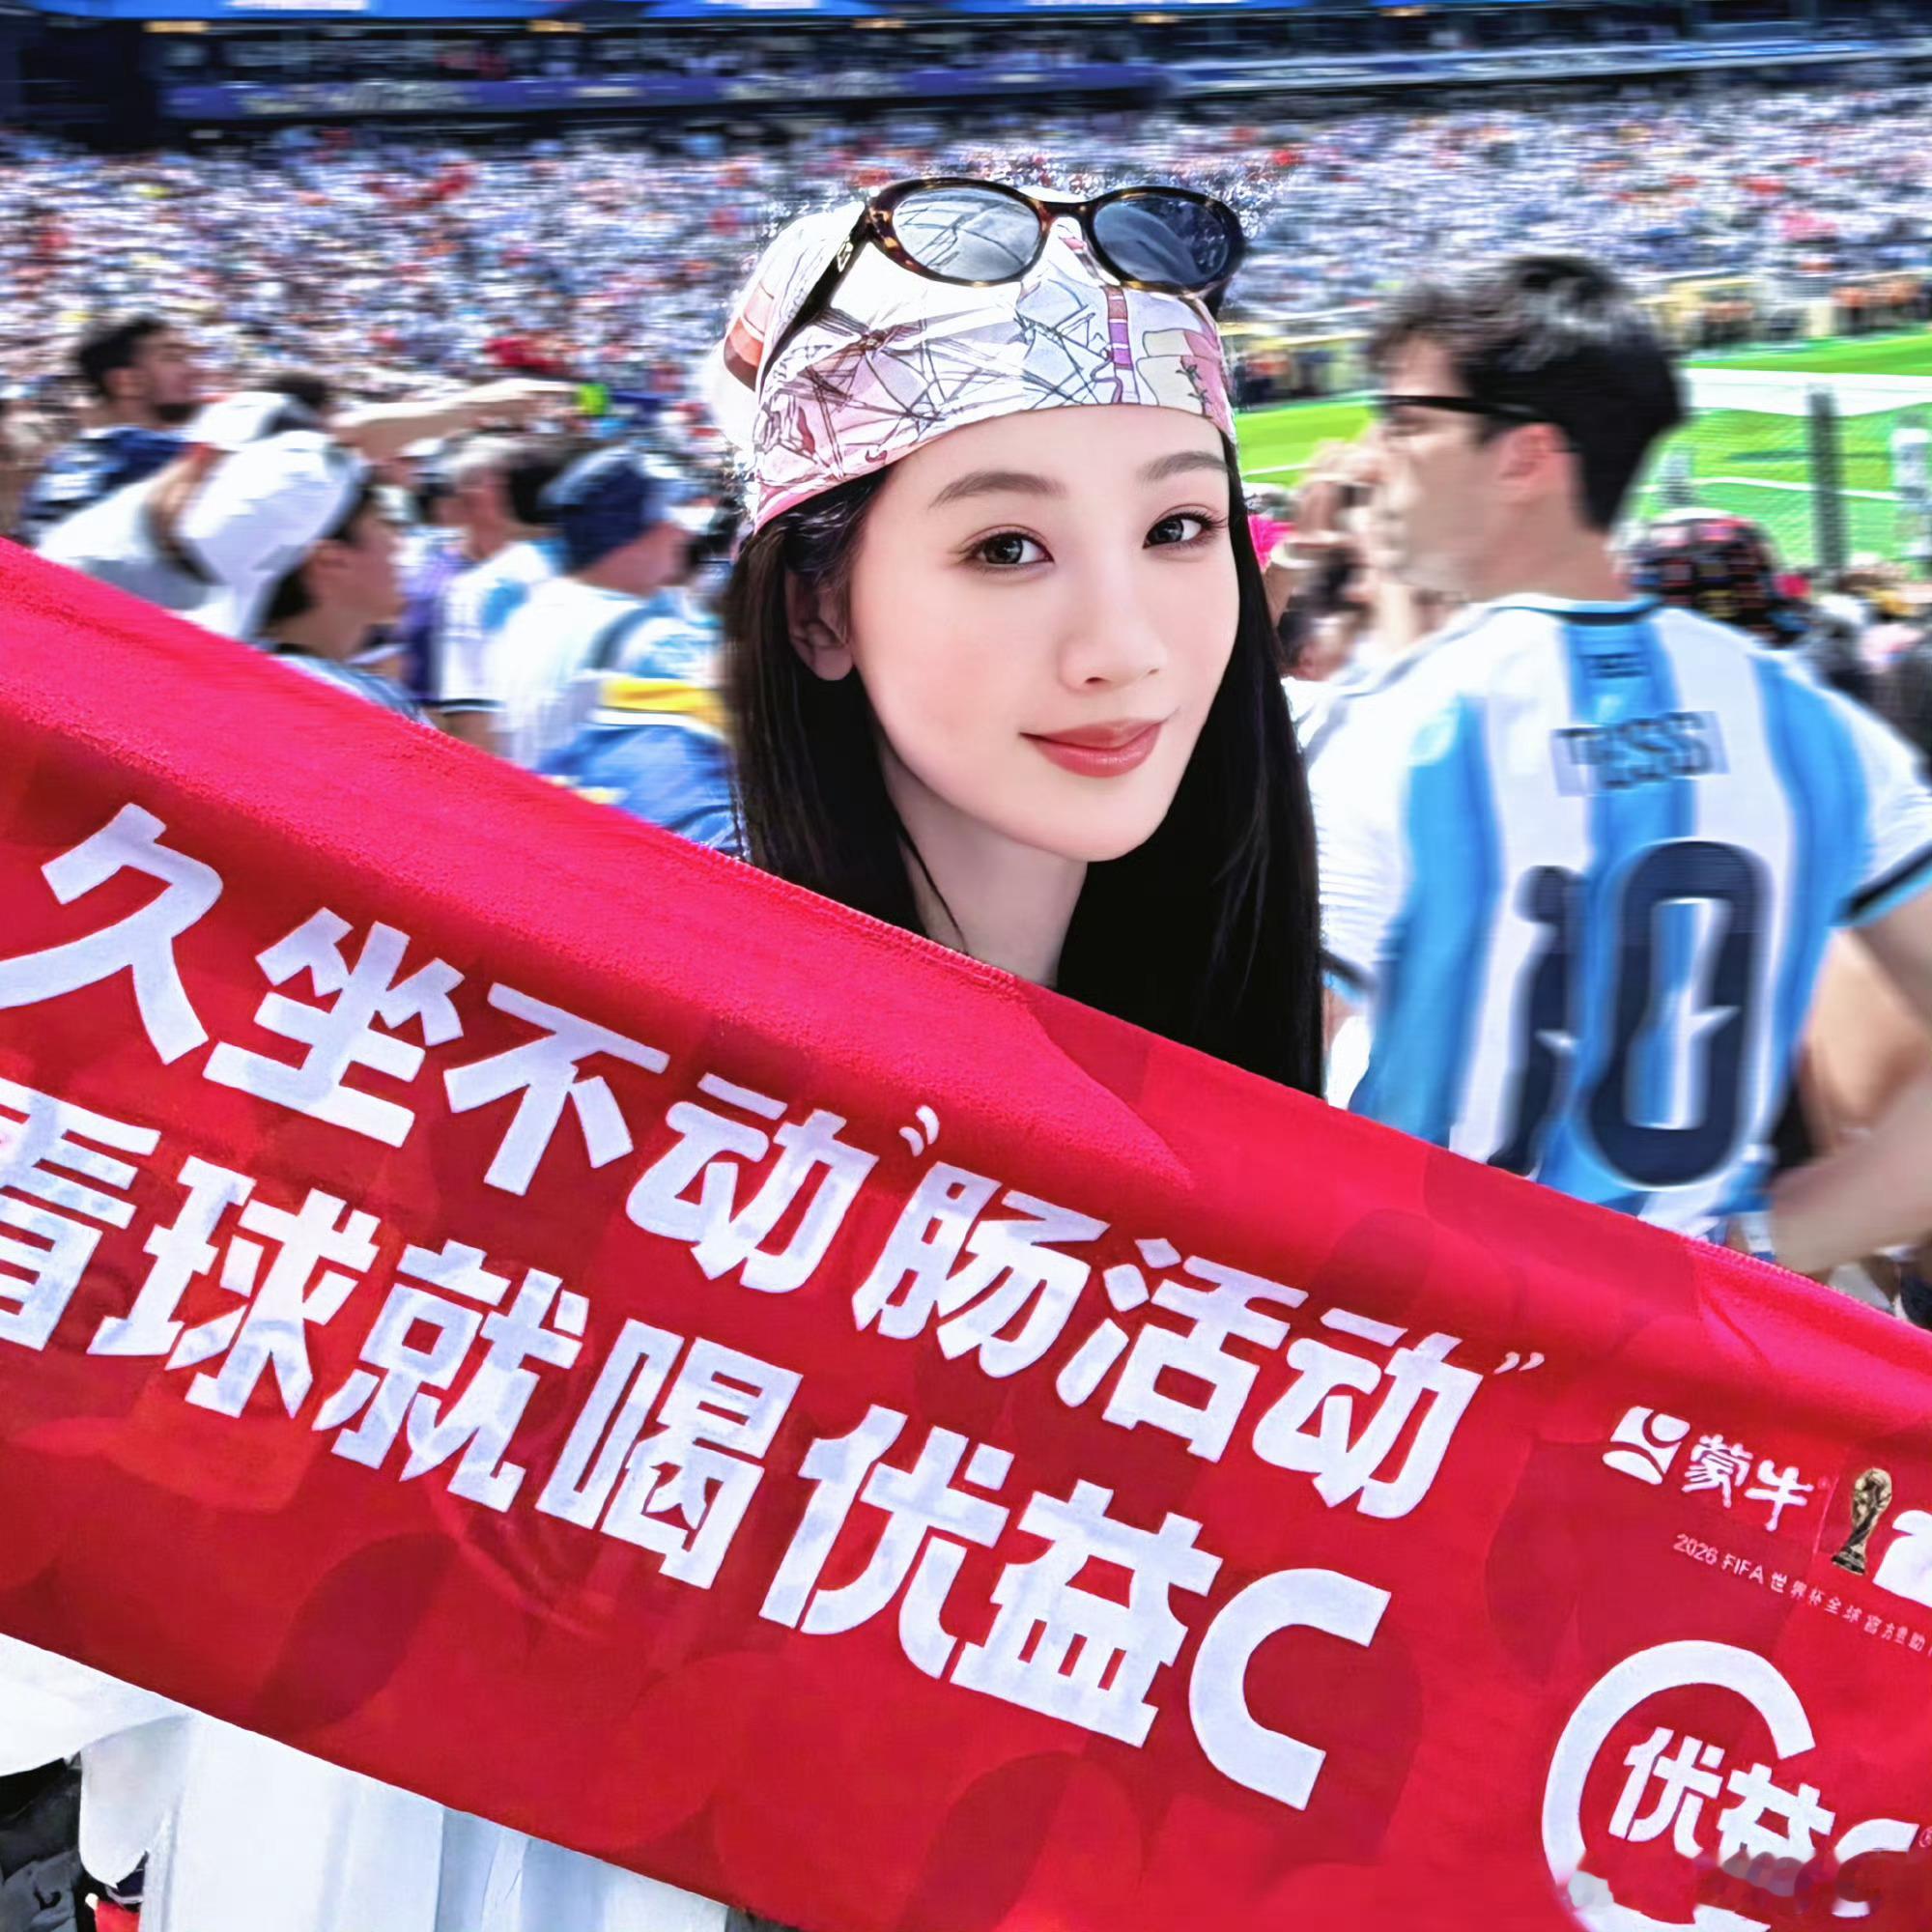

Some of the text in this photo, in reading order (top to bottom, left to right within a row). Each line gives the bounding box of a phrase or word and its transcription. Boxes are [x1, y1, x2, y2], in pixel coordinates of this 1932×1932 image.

[1683, 1434, 1814, 1532] 蒙牛
[1673, 1534, 1719, 1566] 2026
[1722, 1553, 1764, 1585] FIFA
